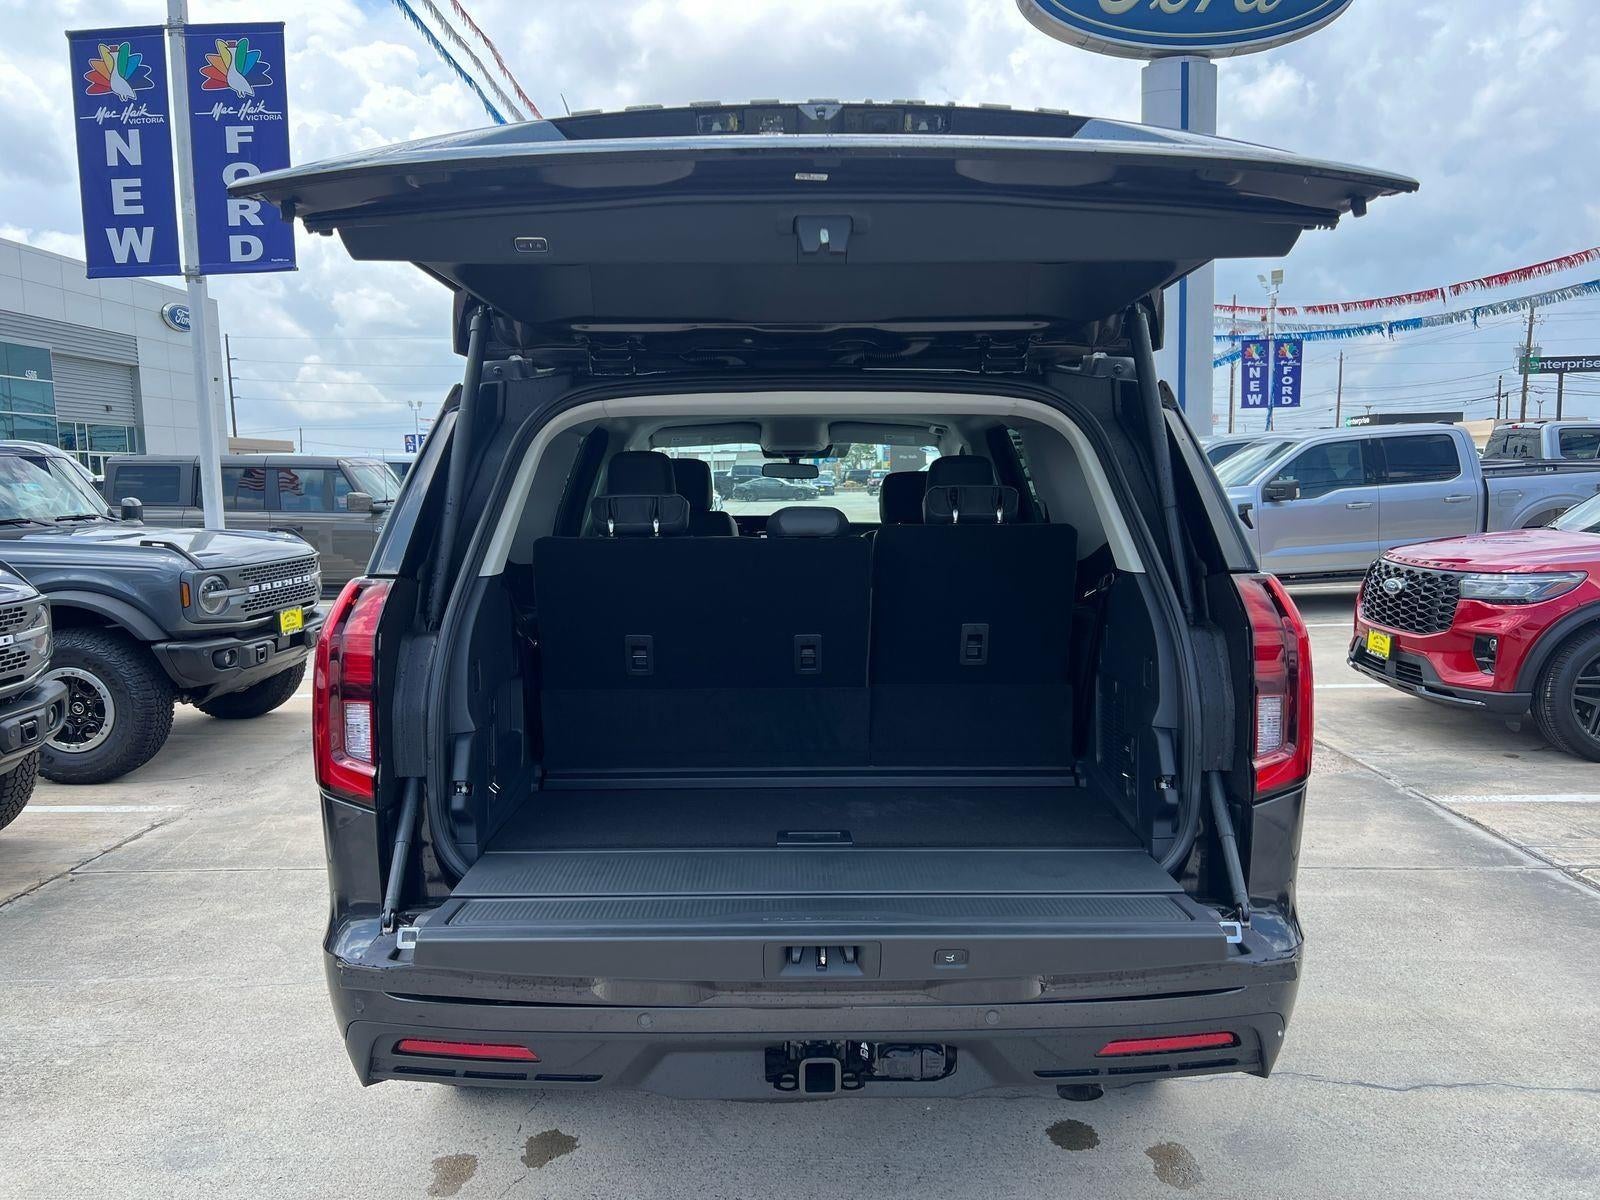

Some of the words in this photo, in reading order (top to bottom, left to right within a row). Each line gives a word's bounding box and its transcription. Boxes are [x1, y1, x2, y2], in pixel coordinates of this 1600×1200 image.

[128, 117, 165, 125] VICTORIA
[237, 99, 270, 120] Haik
[245, 114, 283, 122] VICTORIA
[104, 128, 155, 264] NEW
[222, 125, 265, 263] FORD
[1247, 367, 1262, 405] NEW
[1281, 366, 1293, 405] FORD
[248, 575, 311, 594] BRONCO
